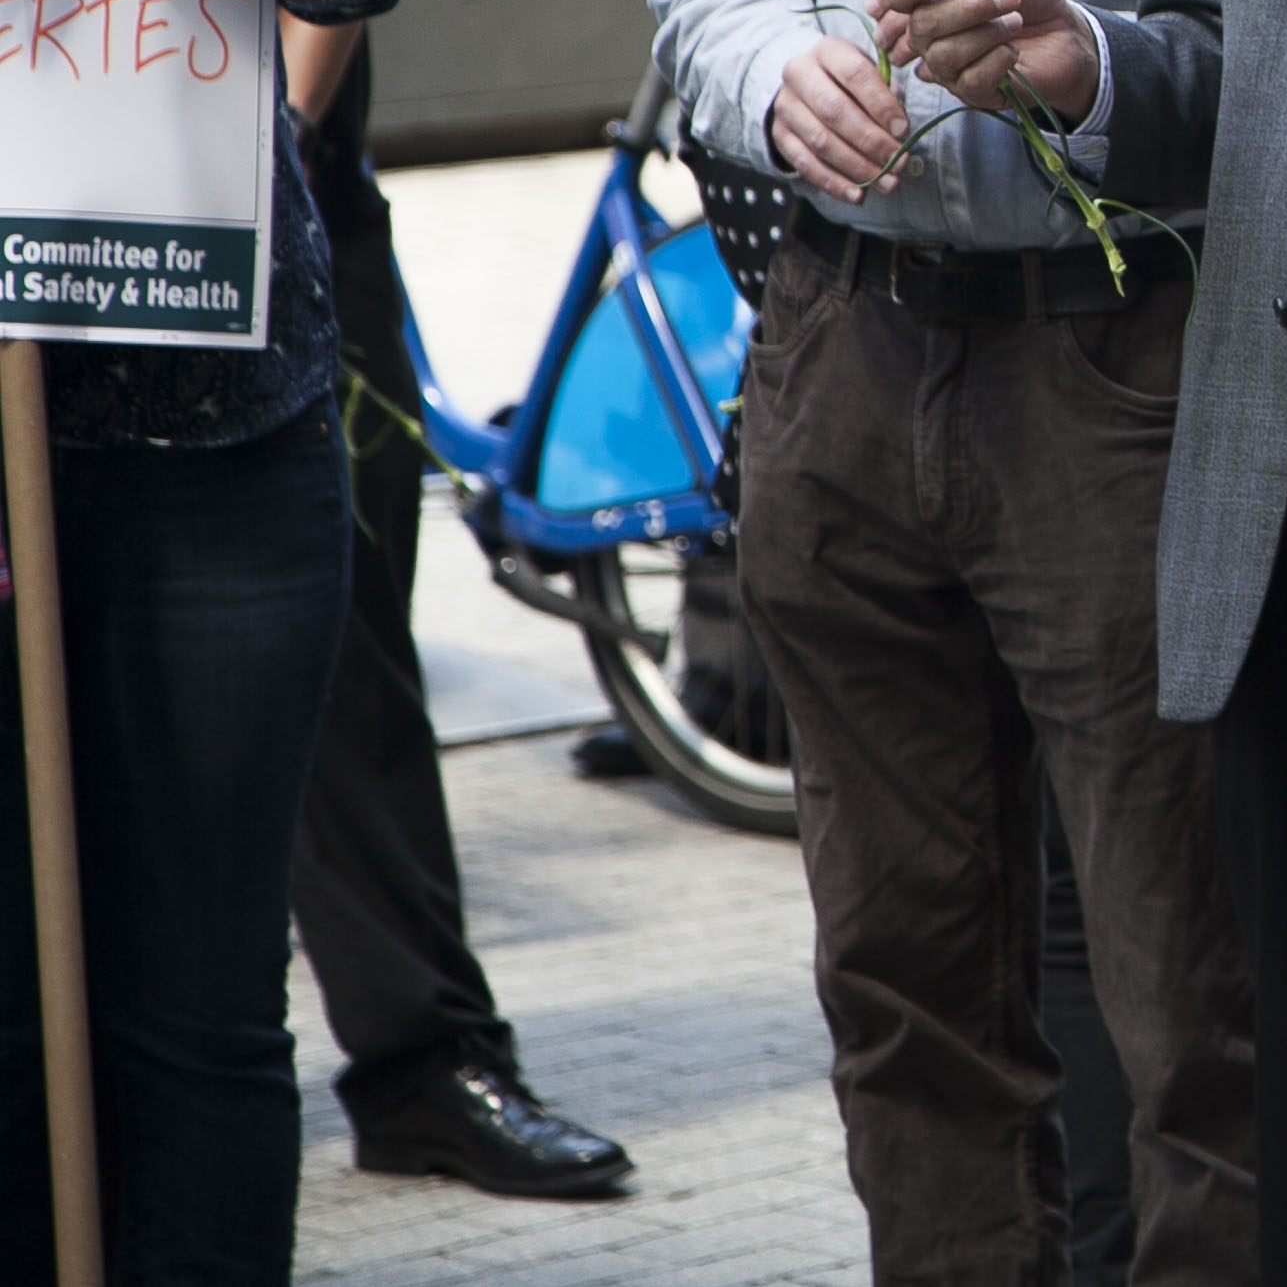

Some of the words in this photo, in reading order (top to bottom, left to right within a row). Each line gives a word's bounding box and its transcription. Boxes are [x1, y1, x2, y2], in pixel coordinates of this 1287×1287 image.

[3, 233, 158, 271] Committee
[165, 239, 207, 272] for
[22, 271, 116, 313] Safety
[121, 276, 140, 307] &
[146, 277, 240, 311] Health
